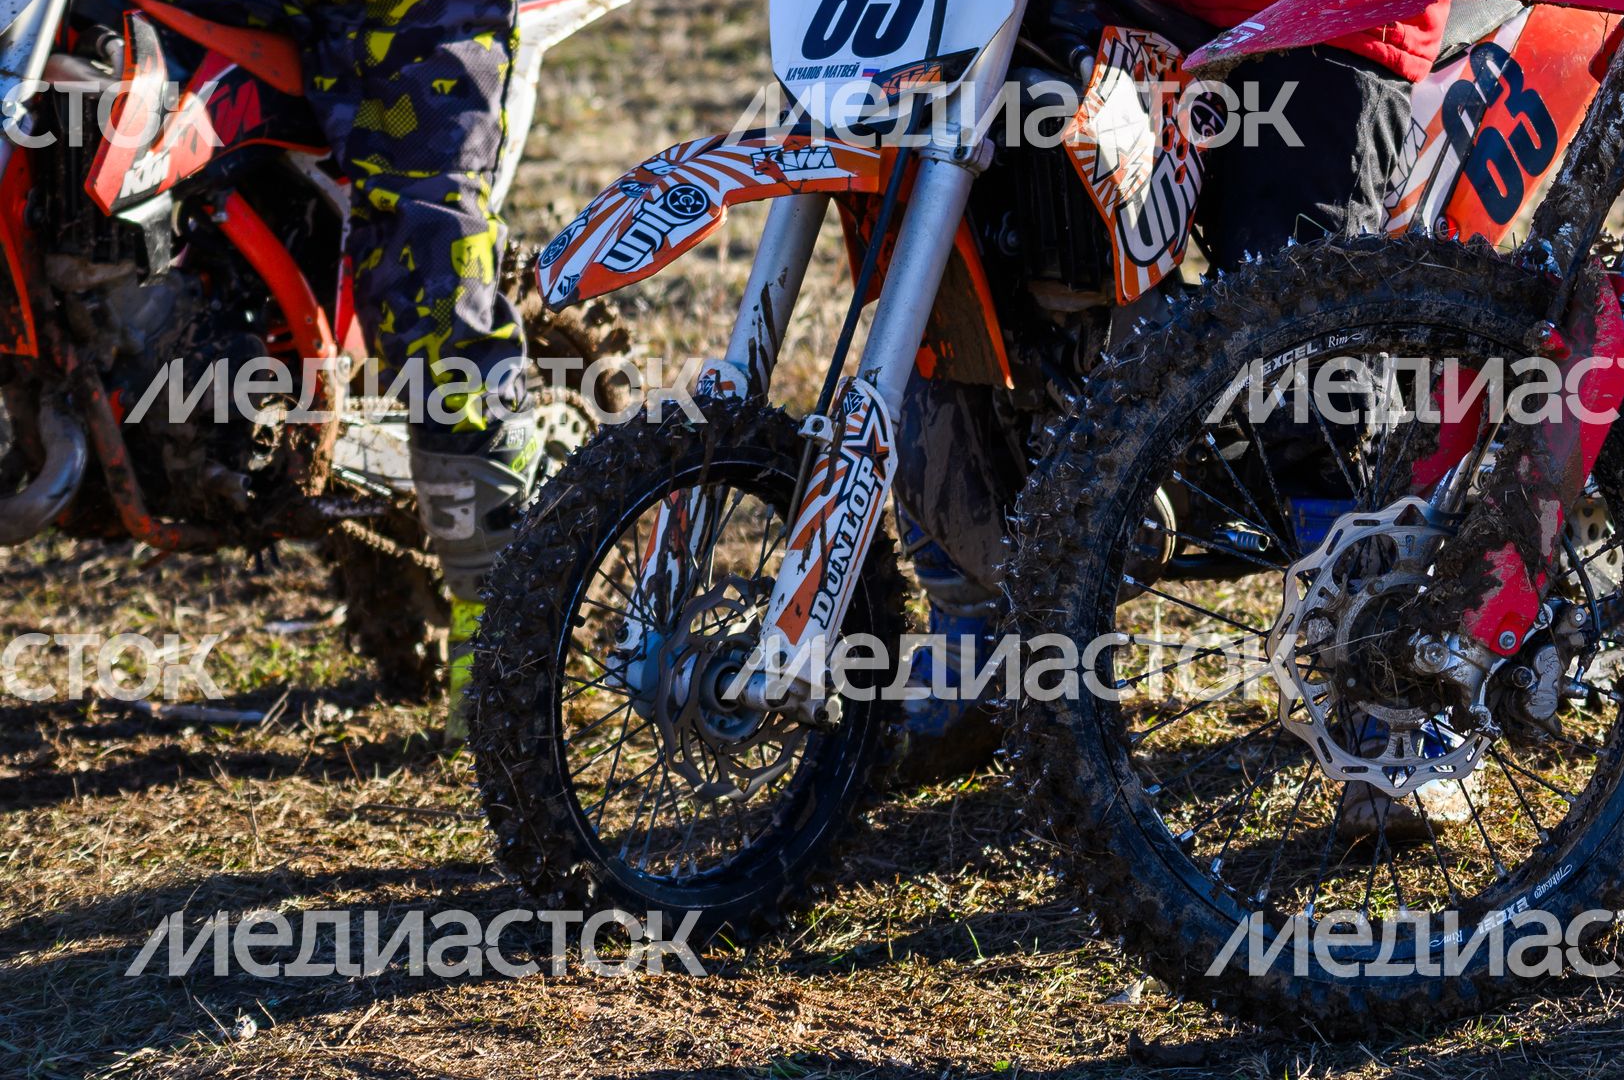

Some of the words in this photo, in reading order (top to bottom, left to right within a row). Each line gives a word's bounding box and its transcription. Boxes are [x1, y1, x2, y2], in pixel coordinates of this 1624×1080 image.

[785, 66, 821, 82] КАЧАЛОВ
[822, 62, 861, 78] МАТВЕЙ
[1442, 41, 1559, 225] 63
[1261, 342, 1318, 376] EXCEL
[808, 454, 876, 630] DUNLOP
